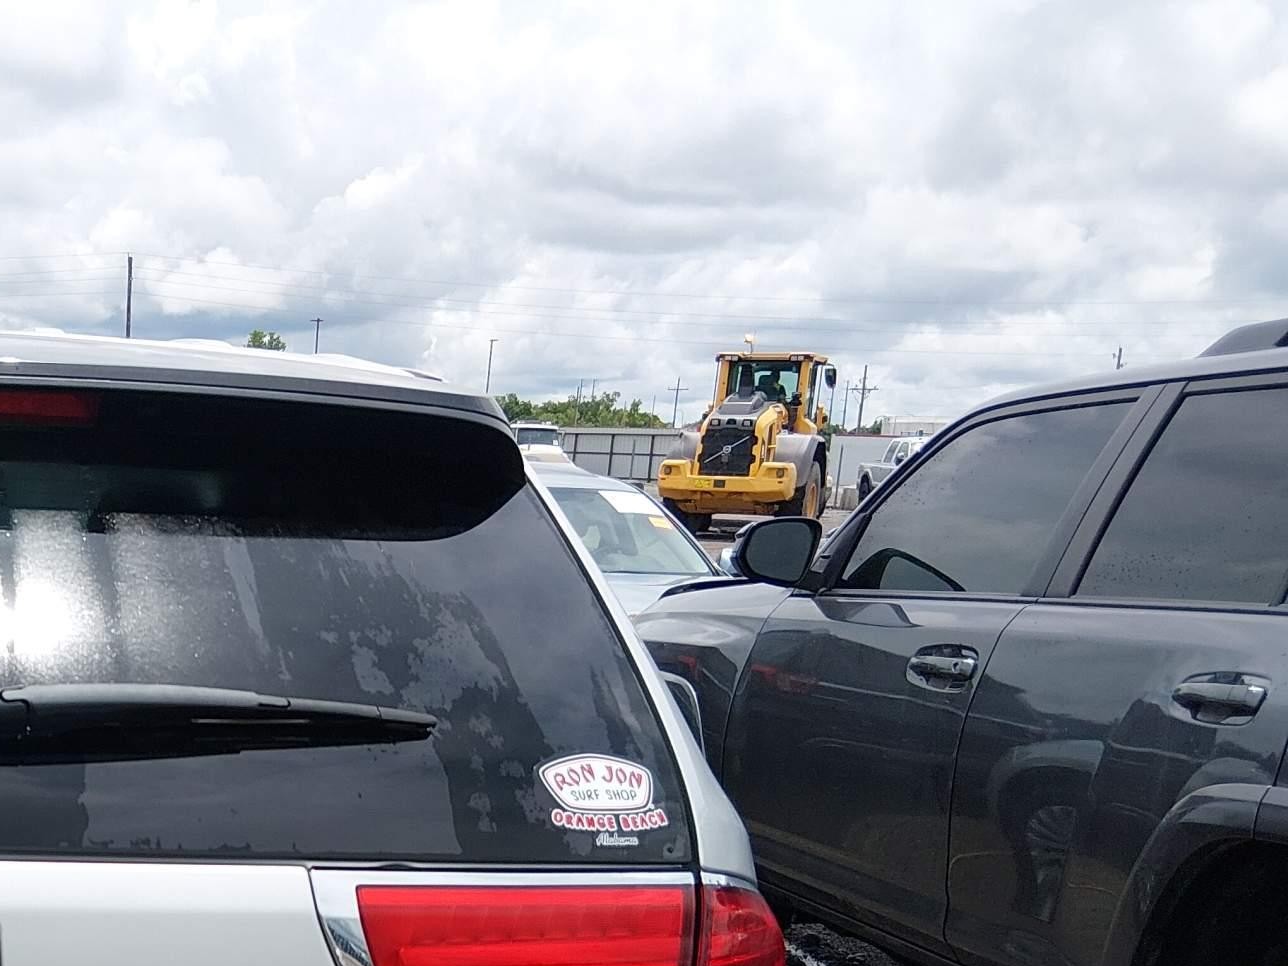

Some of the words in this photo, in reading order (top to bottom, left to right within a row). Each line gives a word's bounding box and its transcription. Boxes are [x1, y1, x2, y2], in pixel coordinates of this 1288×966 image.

[553, 763, 595, 791] RON
[602, 764, 643, 789] JON
[571, 789, 599, 801] SURF
[605, 789, 637, 801] SHOP
[552, 809, 617, 831] ORANGE
[619, 809, 668, 831] BEACH
[595, 832, 640, 846] Alabama
